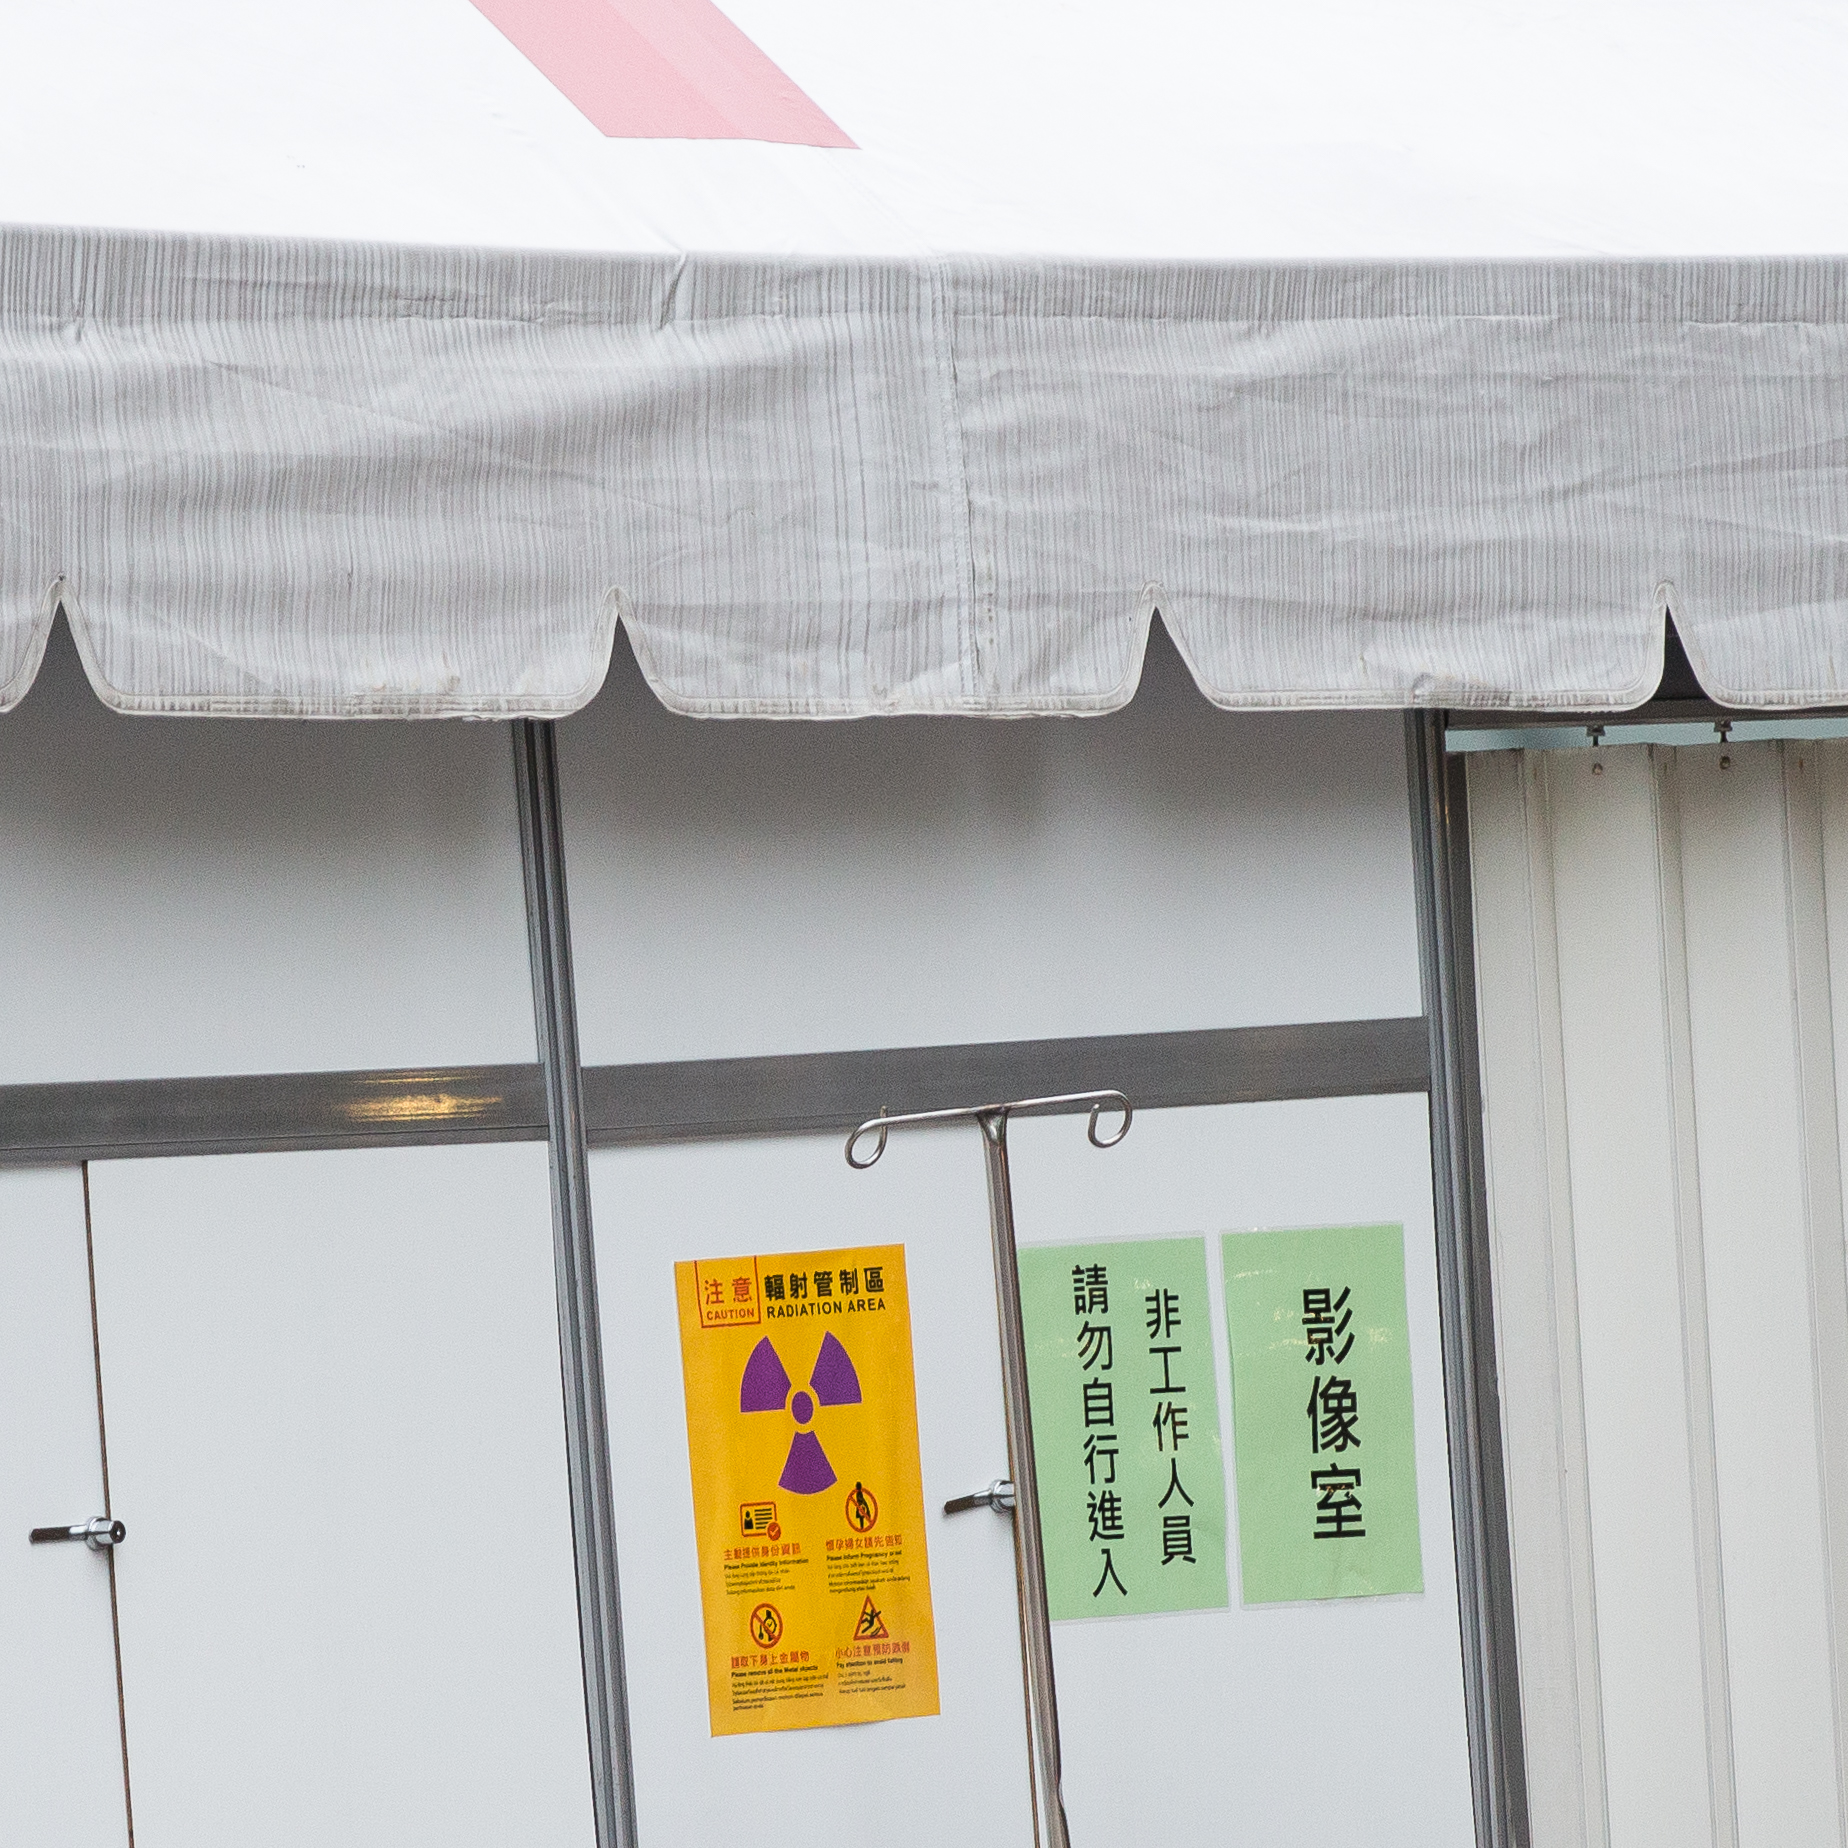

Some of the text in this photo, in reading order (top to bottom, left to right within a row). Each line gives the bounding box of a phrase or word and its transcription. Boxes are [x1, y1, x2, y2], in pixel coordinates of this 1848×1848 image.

[704, 1276, 753, 1305] 注意
[763, 1266, 885, 1302] 輻射管制區
[706, 1307, 755, 1321] CAUTION
[766, 1298, 886, 1319] RADIATION AREA
[1145, 1288, 1197, 1567] 非工作人員
[1301, 1285, 1367, 1540] 影像室
[1071, 1263, 1129, 1599] 請勿自行進入
